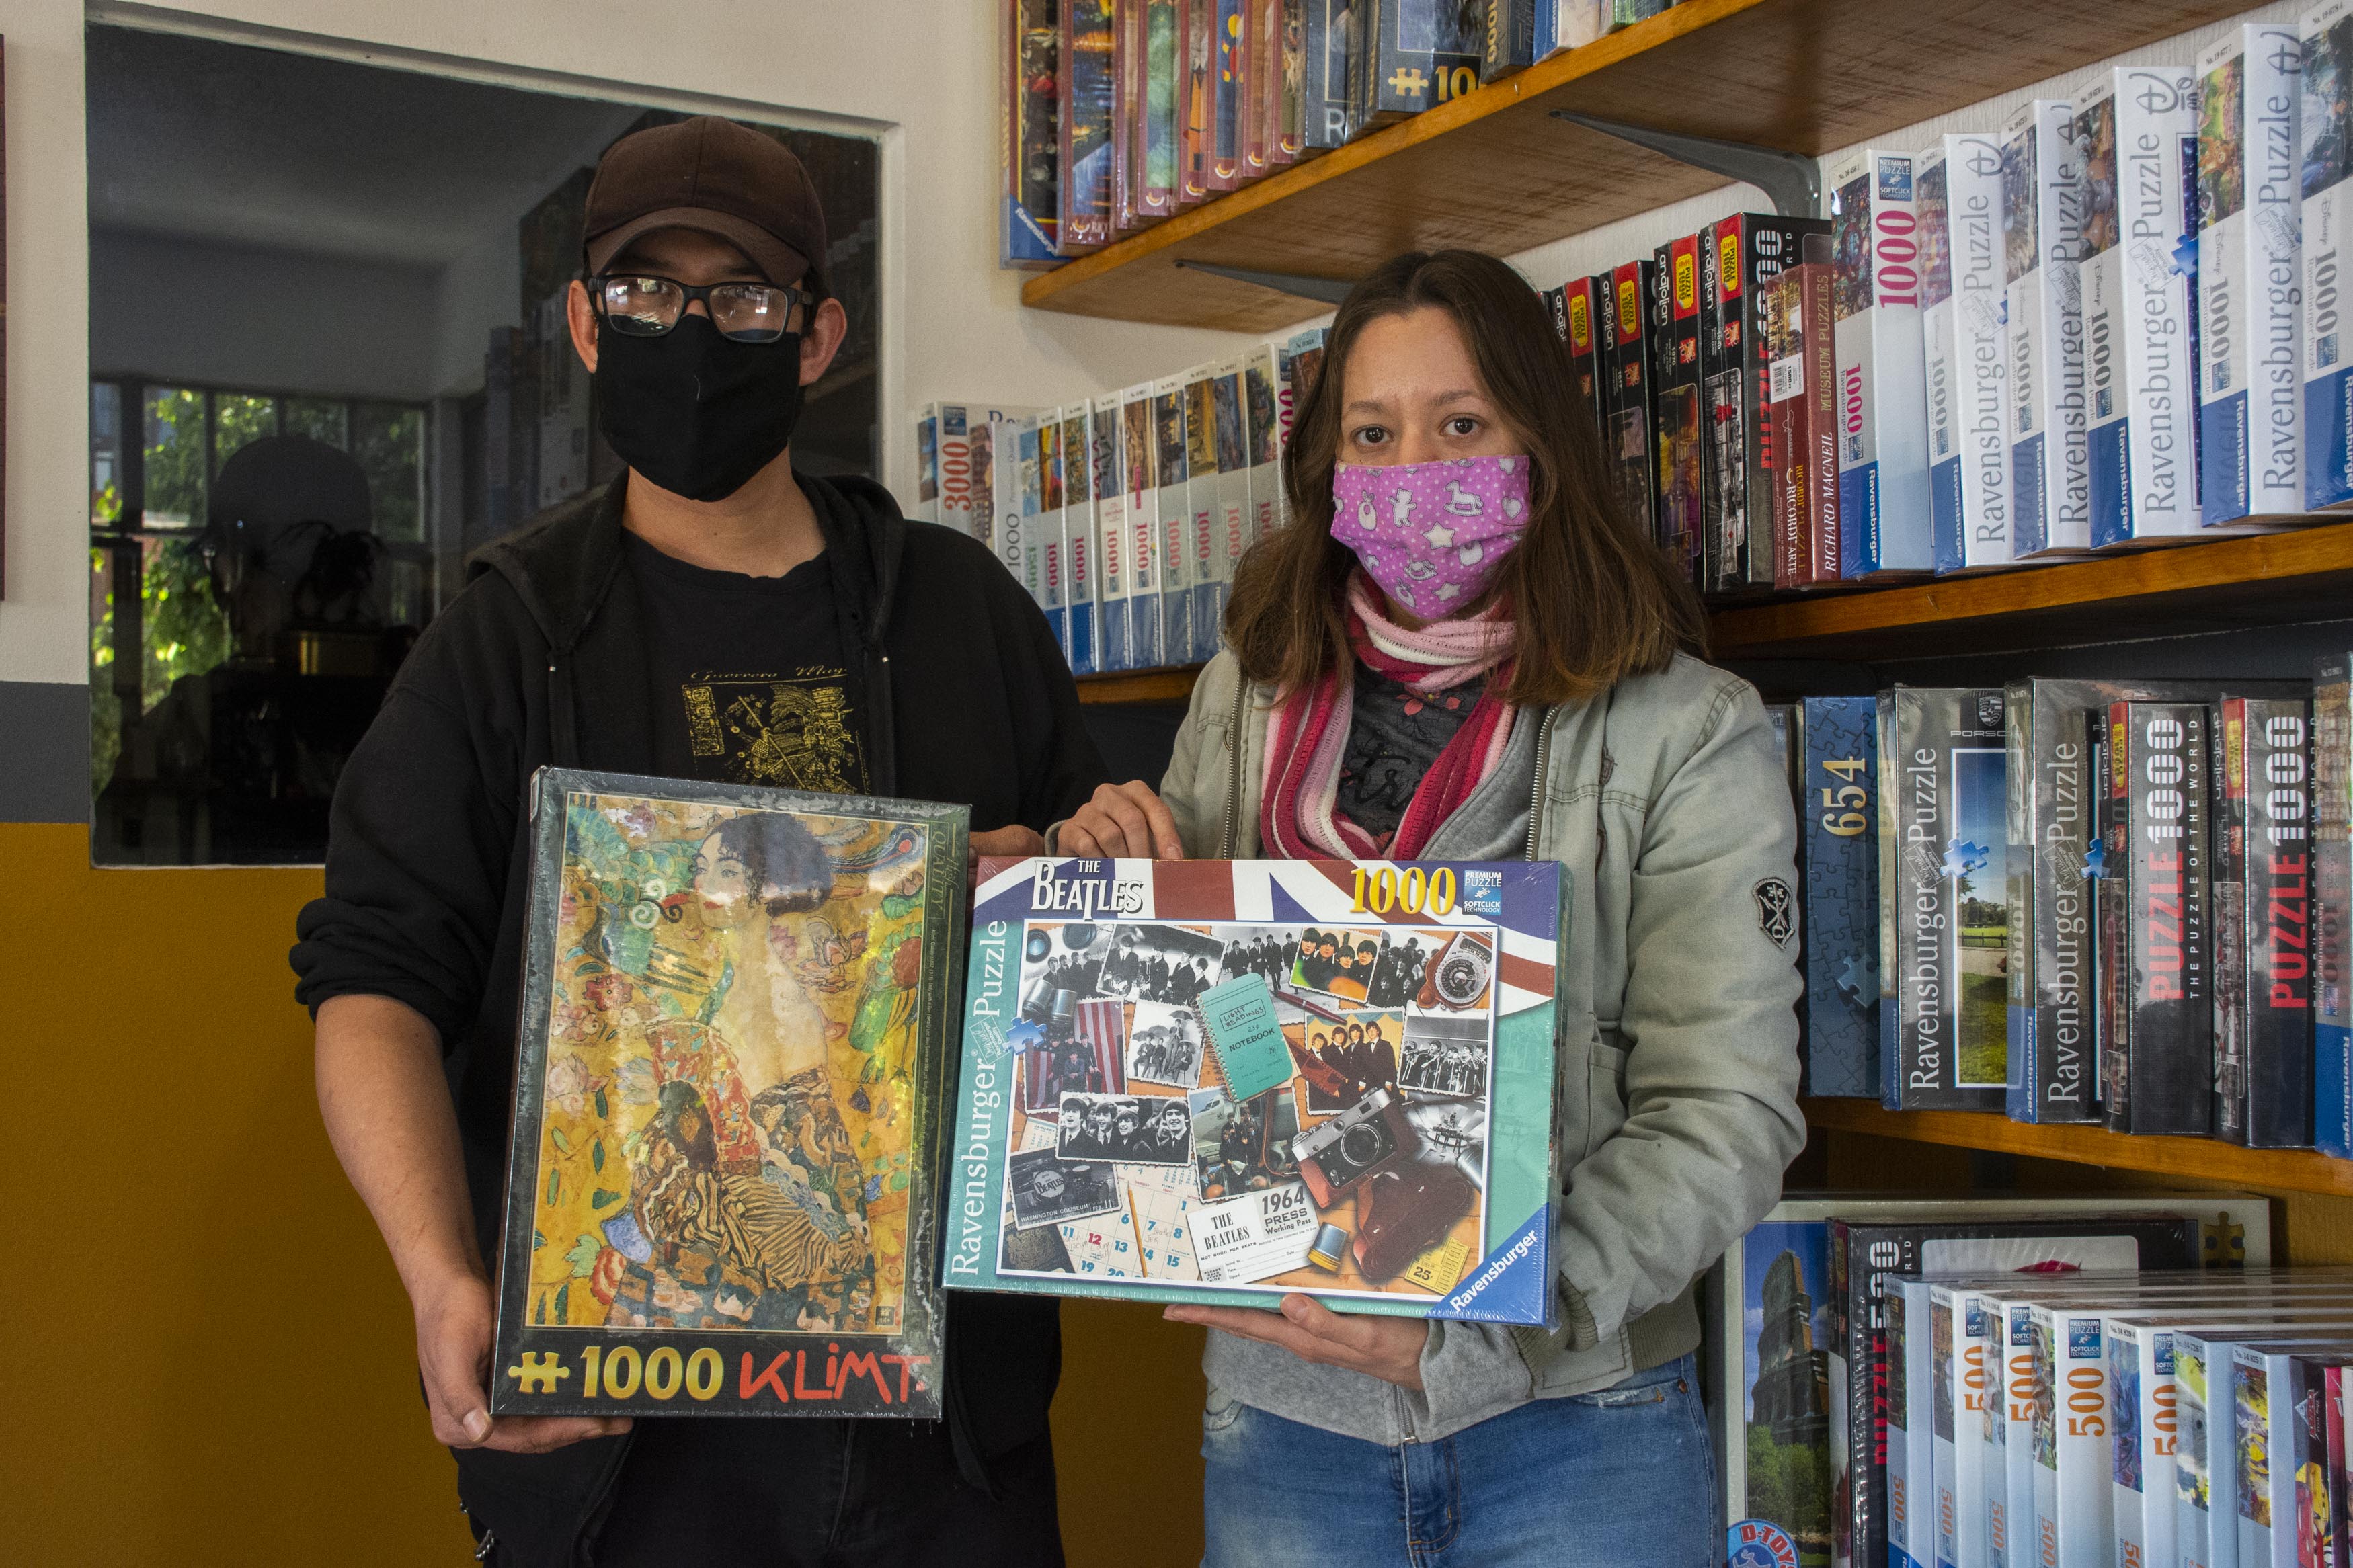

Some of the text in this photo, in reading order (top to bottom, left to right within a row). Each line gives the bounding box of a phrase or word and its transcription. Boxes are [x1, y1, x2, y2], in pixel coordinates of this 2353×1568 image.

[1879, 159, 1910, 168] PREMIUM
[1880, 166, 1910, 175] PUZZLE
[1659, 254, 1670, 326] anatolian
[1679, 270, 1687, 301] 1000
[1722, 250, 1732, 283] 1000
[1875, 210, 1919, 309] 1000
[2259, 94, 2302, 491] Puzzle Ravensburger
[2315, 246, 2338, 333] 1000
[1818, 274, 1832, 412] MUSEUM PUZZLES
[2048, 162, 2089, 525] Puzzle Ravensburger
[2091, 308, 2112, 386] 1000
[2129, 134, 2178, 515] Puzzle Ravensburger
[2209, 276, 2230, 359] 1000
[1845, 363, 1863, 434] 1000
[1931, 354, 1948, 427] 1000
[1960, 194, 2006, 545] Puzzle Ravensburger
[2016, 327, 2032, 402] 1000
[2234, 400, 2247, 509] Ravensburger
[2344, 375, 2353, 490] Ravensburger
[942, 440, 971, 512] 3000
[1821, 431, 1836, 572] RICHARD MACNEIL
[2036, 441, 2044, 540] Ravensburger
[2118, 426, 2128, 531] Ravensburger
[1006, 513, 1021, 567] 1000
[1135, 522, 1149, 569] 1000
[1168, 519, 1181, 568] 1000
[1197, 509, 1211, 560] 1000
[1227, 507, 1241, 556] 1000
[1786, 485, 1798, 575] RICORDI ARTE
[1796, 464, 1804, 574] RICORDI PUZZLE
[1866, 468, 1878, 564] Ravensburger
[1952, 463, 1964, 561] Ravensburger
[1046, 541, 1059, 587] 1000
[1074, 536, 1086, 581] 1000
[1107, 528, 1119, 575] 1000
[1822, 756, 1867, 837] 654
[2146, 719, 2184, 844] 1000
[2265, 716, 2305, 846] 1000
[932, 831, 947, 911] QUALITY
[1031, 860, 1144, 921] BEATLES
[1078, 860, 1101, 873] THE
[1350, 867, 1457, 915] 1000
[1464, 878, 1501, 887] PUZZLE
[2188, 720, 2199, 998] THE PUZZLE OF THE WORLD
[1906, 747, 1945, 1091] Puzzle Ravensburger
[2046, 742, 2086, 1103] Puzzle Ravensburger
[2149, 851, 2184, 1000] PUZZLE
[2268, 853, 2308, 1007] PUZZLE
[1223, 1007, 1246, 1022] LIGHT
[1226, 1007, 1264, 1028] READINGS
[1229, 1028, 1275, 1053] NOTEBOOK
[952, 920, 1007, 1275] Puzzle Ravensburger
[2342, 1036, 2350, 1147] Ravensburger
[1020, 1210, 1058, 1223] WASHINGTON
[1060, 1204, 1088, 1214] COLISEUM
[1034, 1178, 1065, 1194] BEATLES
[1181, 1200, 1187, 1211] 1
[1262, 1185, 1306, 1216] 1964
[1265, 1208, 1308, 1227] PRESS
[1063, 1226, 1074, 1238] 11
[1088, 1233, 1103, 1245] 12
[1115, 1240, 1129, 1253] 13
[1166, 1255, 1180, 1268] 15
[1121, 1213, 1183, 1239] 6 7 8
[1203, 1225, 1250, 1251] BEATLES
[1211, 1212, 1234, 1230] THE
[1265, 1218, 1312, 1236] Working Pass
[1081, 1260, 1095, 1272] 19
[1449, 1229, 1538, 1312] Ravensburger
[2069, 1327, 2100, 1335] PUZZLE
[580, 1346, 723, 1402] 1000
[2009, 1354, 2035, 1421] 500
[2067, 1367, 2105, 1437] 500
[2153, 1383, 2177, 1456] 500
[1892, 1475, 1905, 1522] 500
[1941, 1487, 1953, 1534] 500
[1991, 1500, 2005, 1549] 500
[2041, 1516, 2056, 1567] 500
